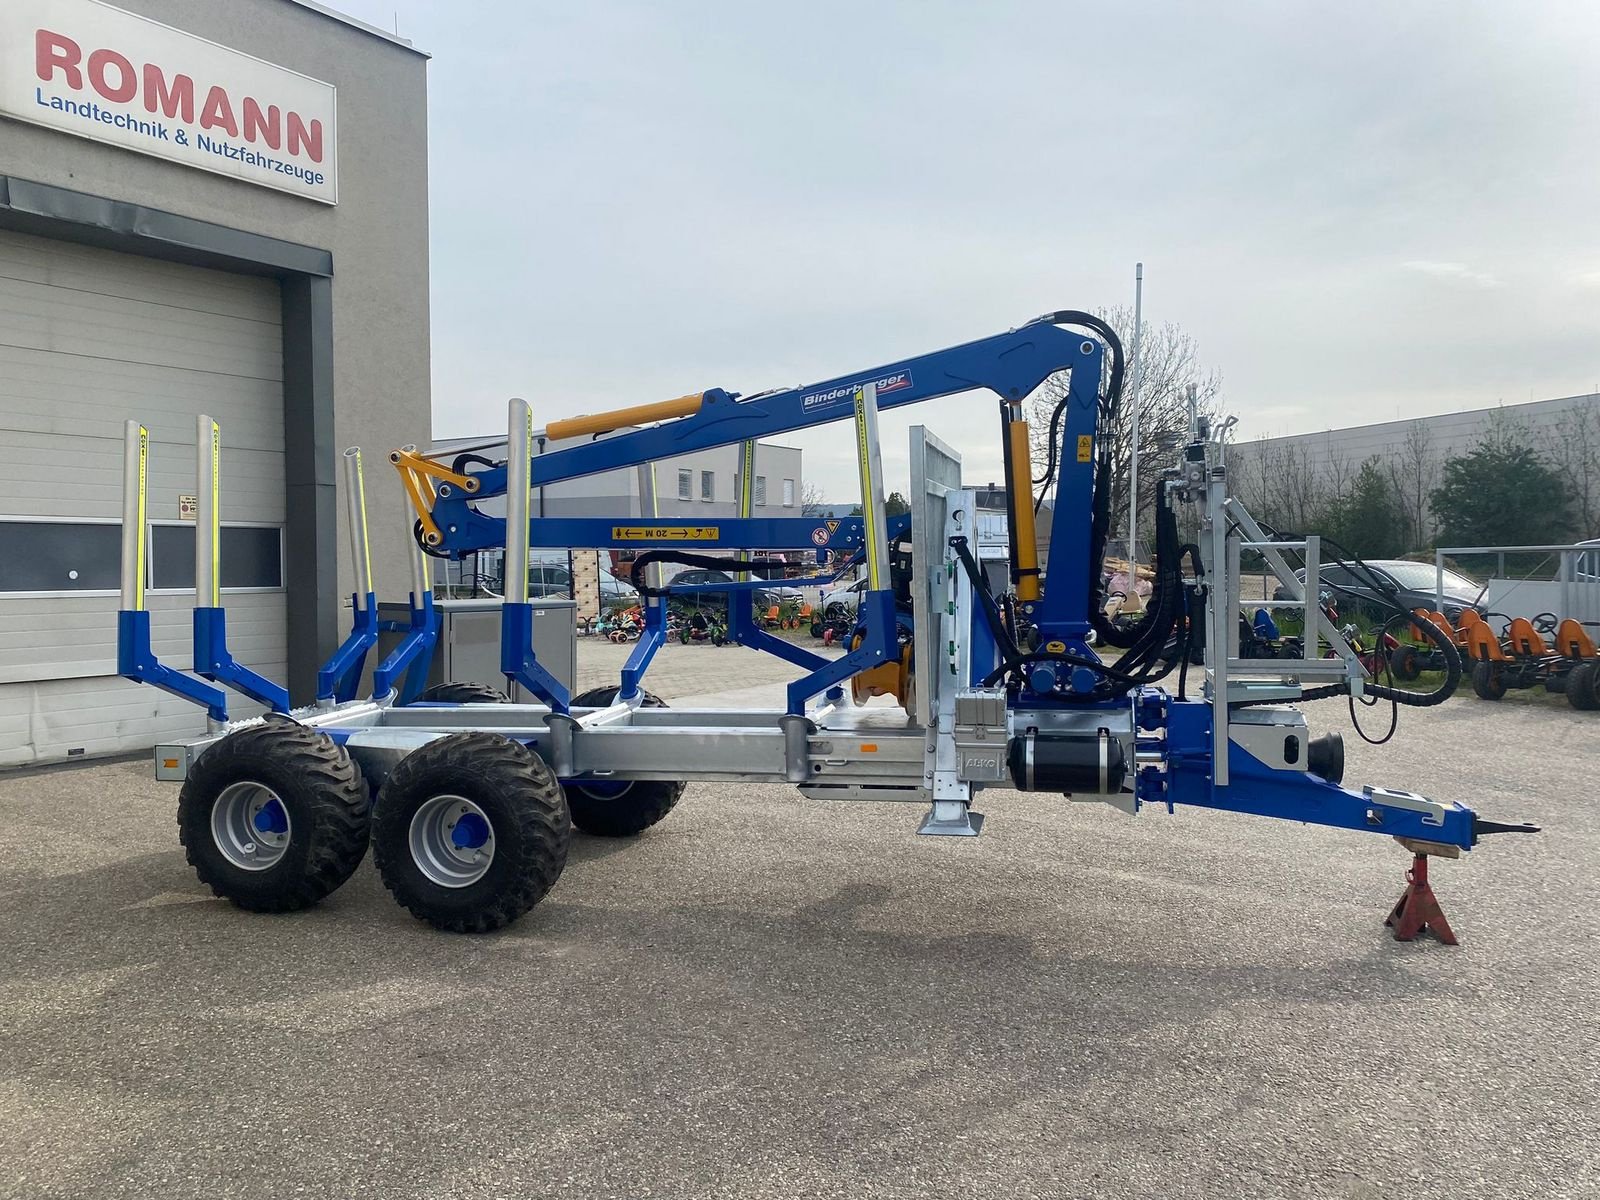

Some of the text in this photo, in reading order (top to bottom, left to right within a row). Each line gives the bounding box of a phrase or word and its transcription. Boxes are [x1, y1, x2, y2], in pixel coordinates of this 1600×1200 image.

[35, 28, 324, 164] ROMANN
[35, 87, 324, 185] Landtechnik & Nutzfahrzeuge
[803, 374, 905, 406] Binderbger
[645, 529, 667, 537] 20 M
